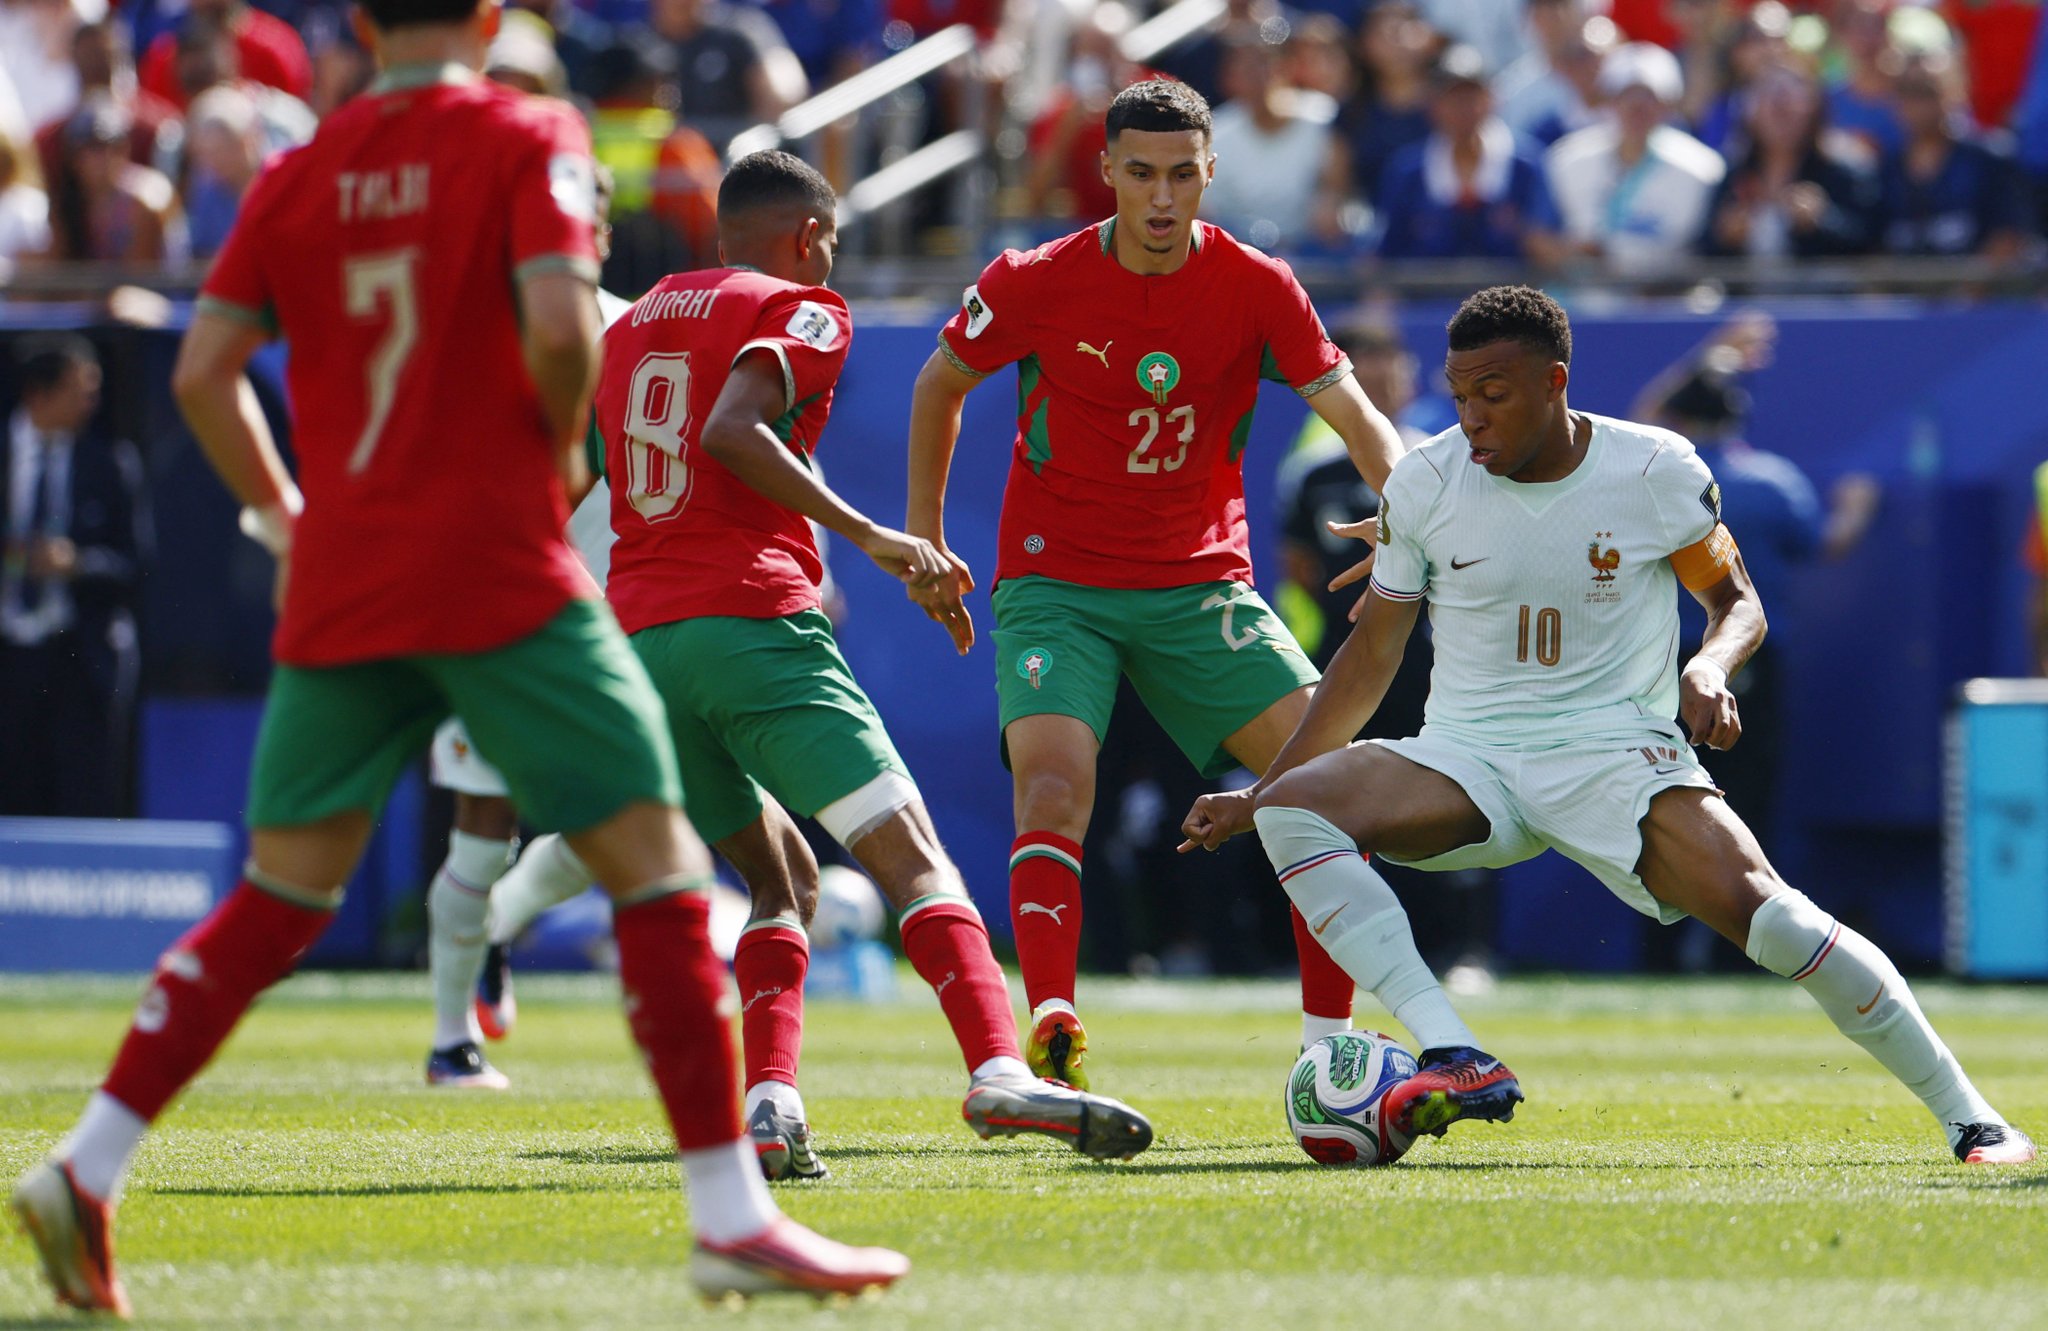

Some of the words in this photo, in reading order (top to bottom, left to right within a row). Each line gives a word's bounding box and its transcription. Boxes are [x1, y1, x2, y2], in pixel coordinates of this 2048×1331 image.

[631, 288, 721, 328] OUNAHI
[346, 248, 418, 474] 7
[624, 351, 694, 525] 8
[1127, 404, 1196, 474] 23
[1517, 604, 1562, 667] 10
[1352, 1044, 1363, 1080] TRIONDA
